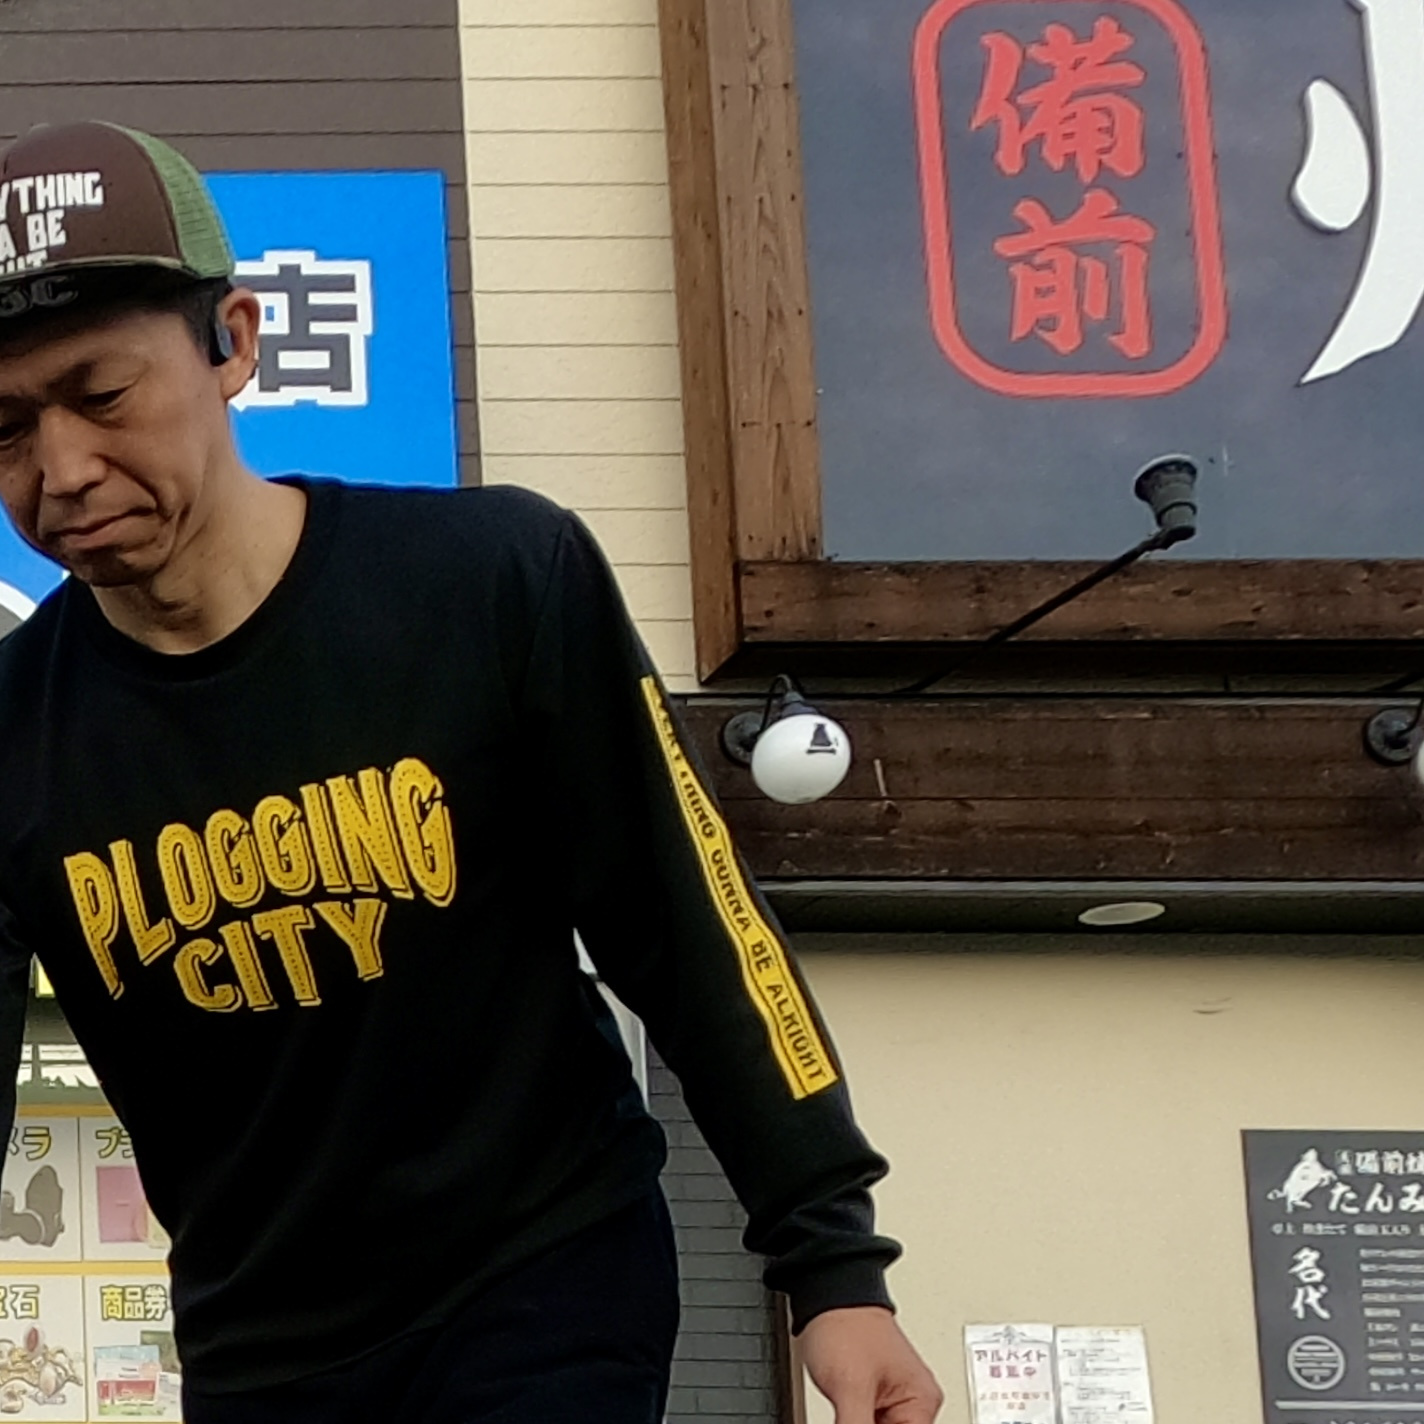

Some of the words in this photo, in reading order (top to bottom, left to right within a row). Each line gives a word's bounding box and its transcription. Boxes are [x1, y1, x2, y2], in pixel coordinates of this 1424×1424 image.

[27, 209, 67, 252] BE
[971, 16, 1155, 358] 備前
[64, 757, 456, 999] PLOGGING
[173, 898, 388, 1012] CITY
[750, 939, 774, 974] BE
[766, 982, 828, 1081] ALRIGHT
[100, 1284, 168, 1321] 商品券
[1287, 1246, 1331, 1320] 名代
